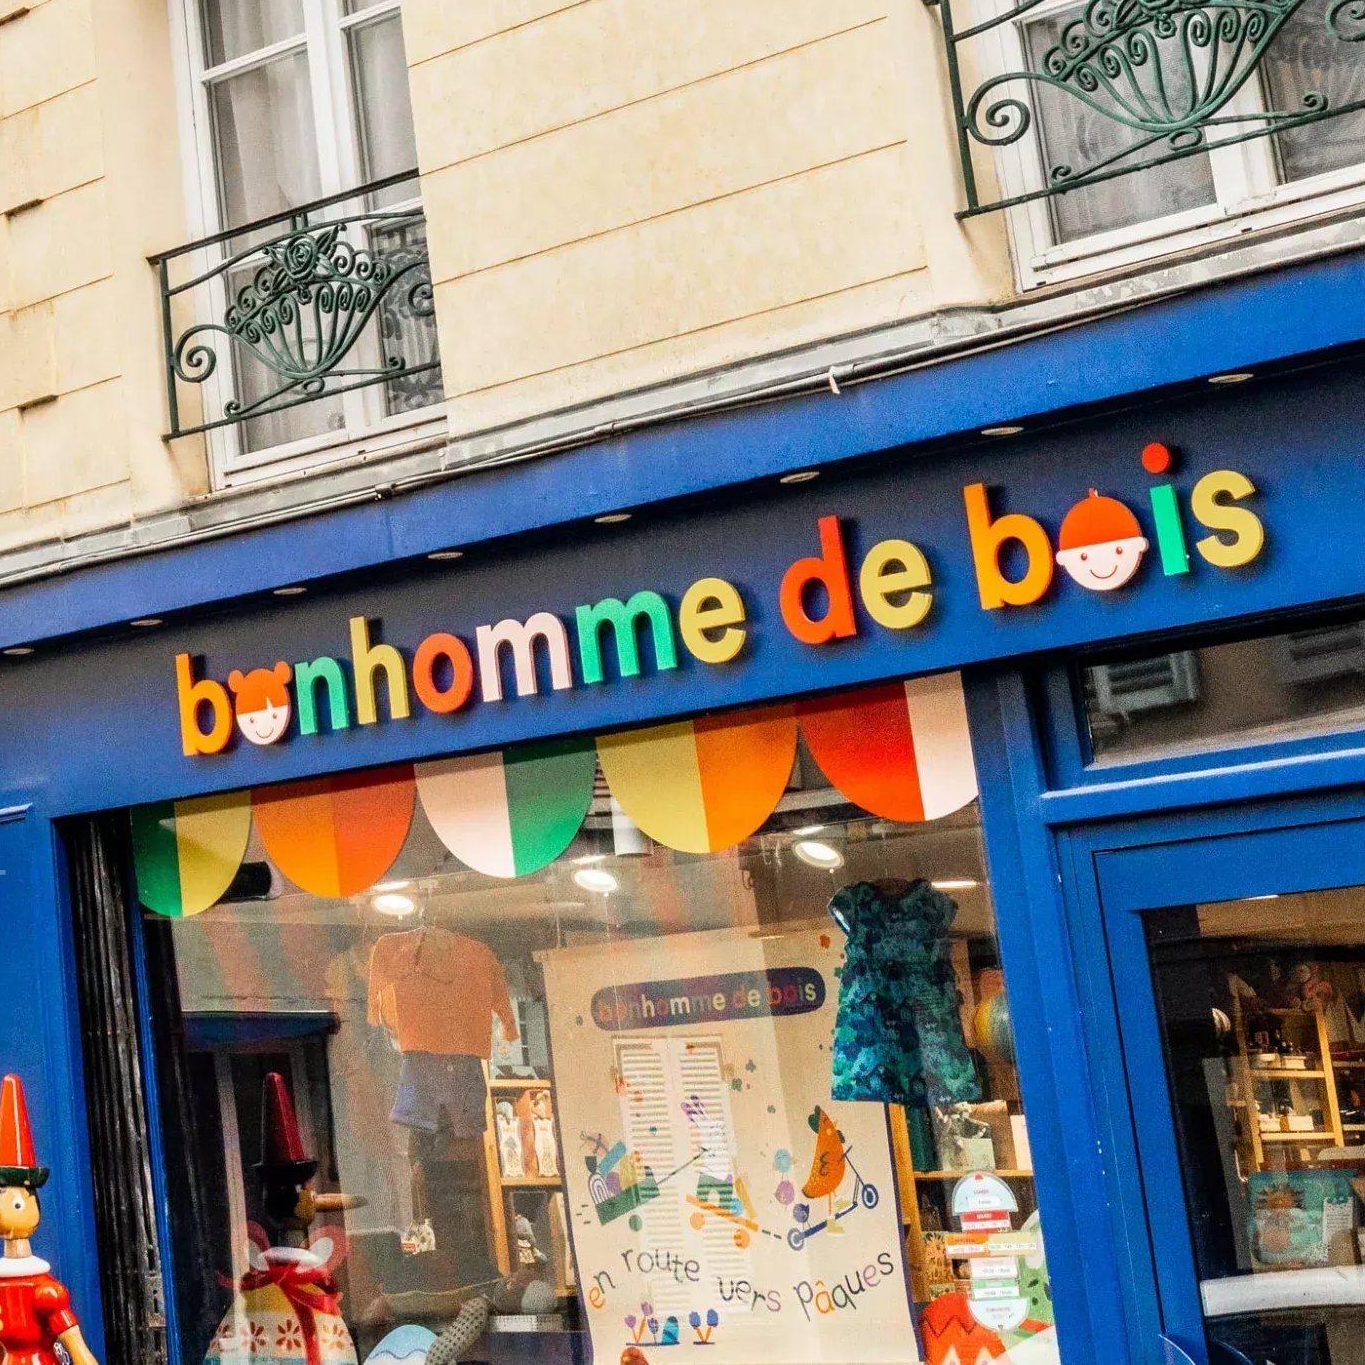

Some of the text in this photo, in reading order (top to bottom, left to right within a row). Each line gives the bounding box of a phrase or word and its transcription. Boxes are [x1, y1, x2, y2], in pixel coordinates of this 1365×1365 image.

[780, 515, 933, 644] de
[732, 984, 762, 1009] de
[766, 976, 817, 1005] bois
[588, 1247, 895, 1323] en route vers pâques
